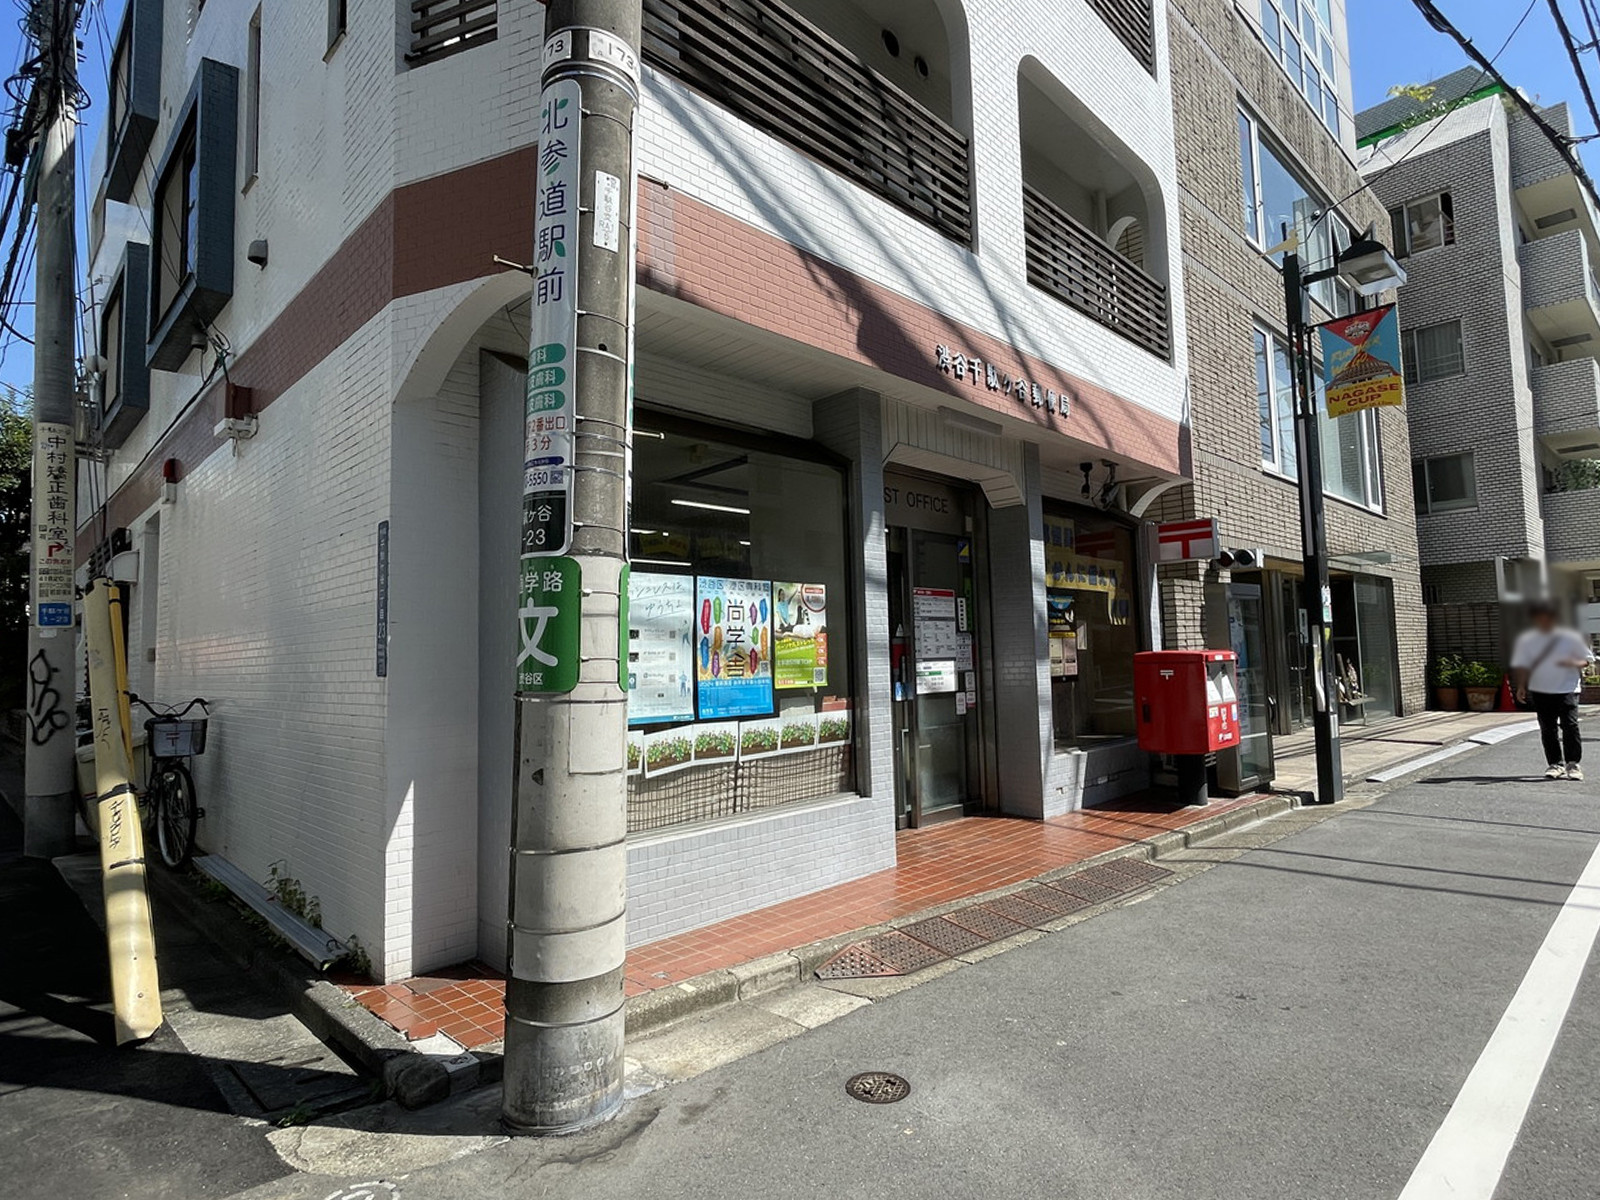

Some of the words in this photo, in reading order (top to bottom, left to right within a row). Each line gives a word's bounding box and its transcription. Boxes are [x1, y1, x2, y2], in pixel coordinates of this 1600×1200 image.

[608, 42, 635, 70] 173
[536, 97, 569, 307] 北参道駅前
[1329, 383, 1399, 404] NAGASE
[1347, 393, 1382, 407] CUP
[907, 491, 949, 514] OFFICE
